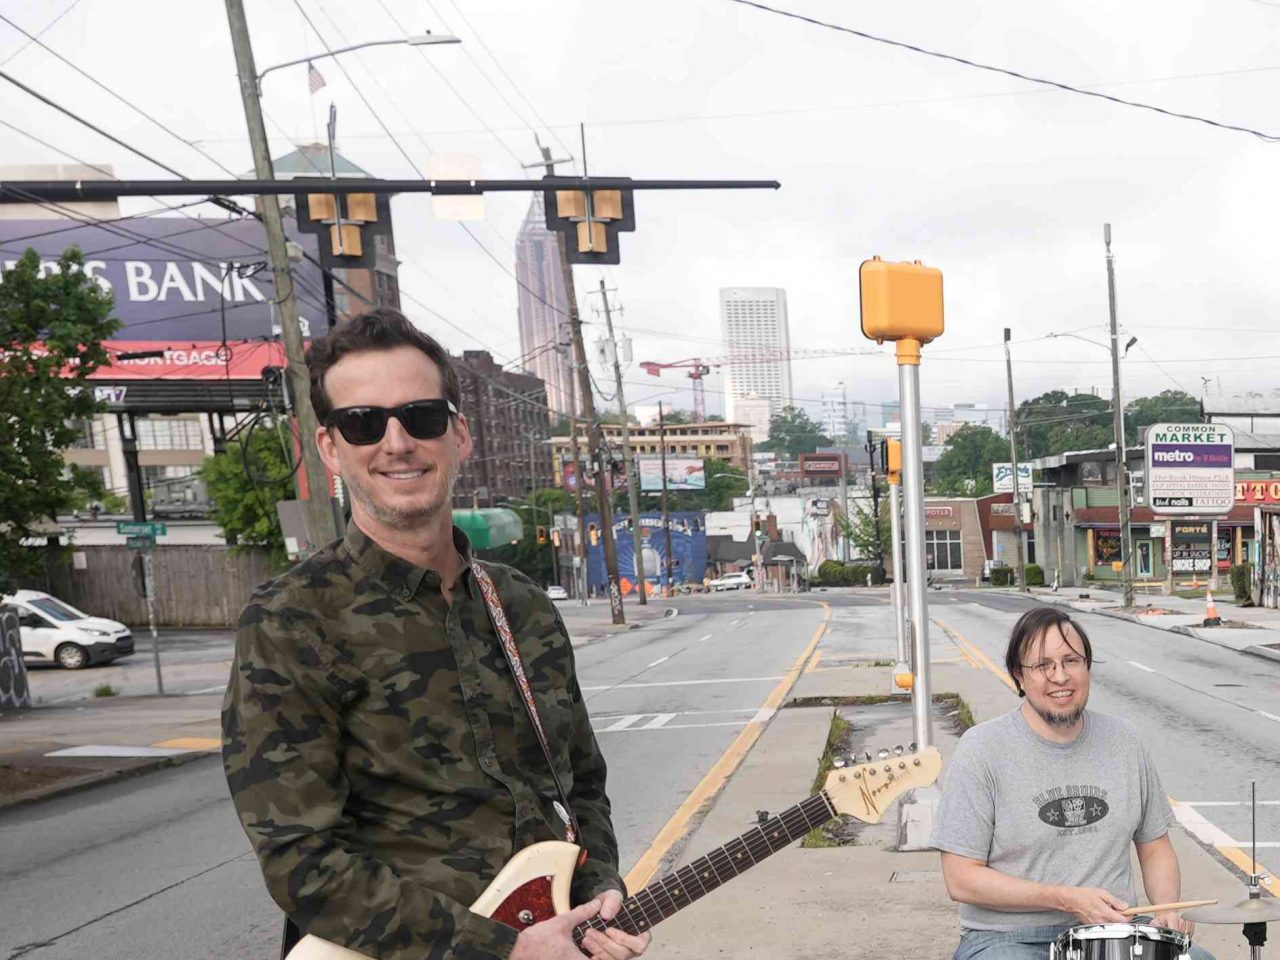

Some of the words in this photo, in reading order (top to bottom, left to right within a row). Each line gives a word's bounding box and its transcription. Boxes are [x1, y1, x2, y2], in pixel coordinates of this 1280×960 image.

[125, 260, 267, 302] BANK
[1155, 433, 1227, 443] MARKET
[1154, 450, 1194, 462] metro
